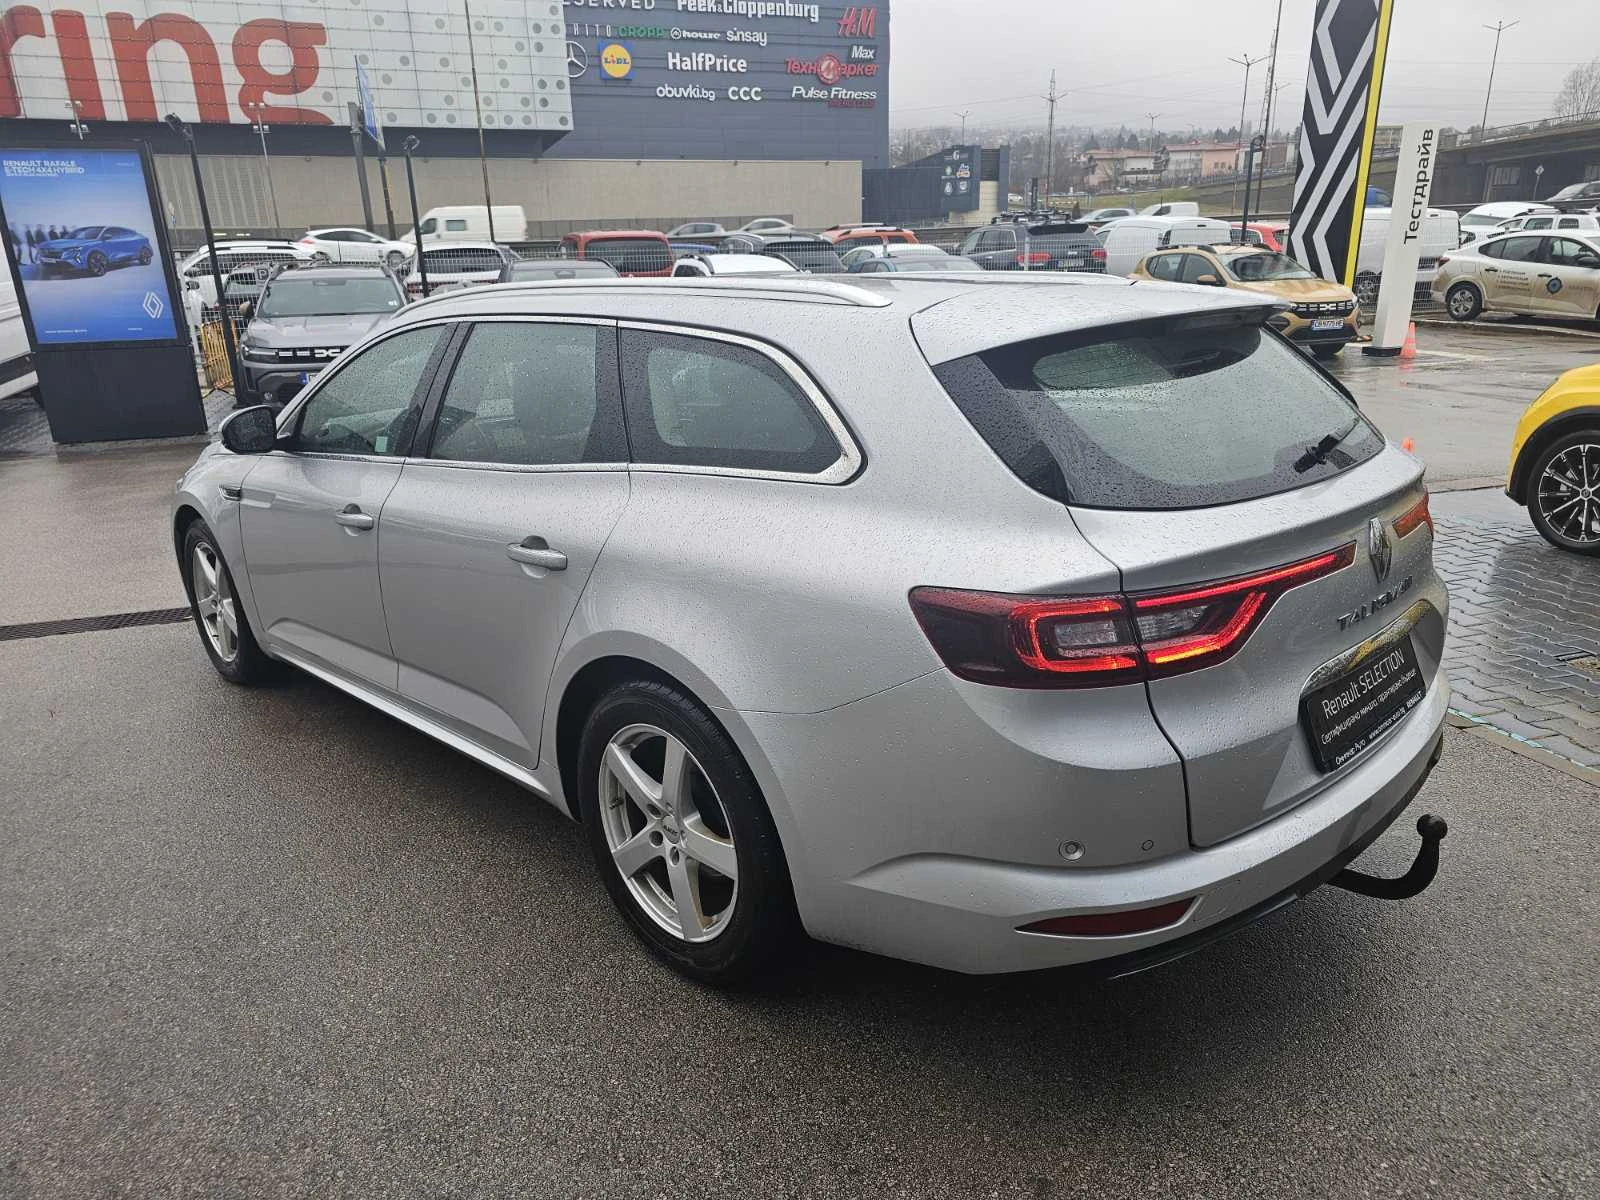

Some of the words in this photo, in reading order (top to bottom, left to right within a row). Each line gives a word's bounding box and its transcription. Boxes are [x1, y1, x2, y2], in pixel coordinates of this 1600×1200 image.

[837, 7, 878, 38] H&M
[667, 51, 748, 72] HalfPrice
[851, 45, 875, 59] Max
[656, 84, 717, 101] obuvki.bg
[727, 86, 763, 101] CCC
[791, 85, 828, 99] Pulse
[830, 87, 878, 100] Fitness
[1404, 128, 1434, 245] Тестдрайв
[1321, 681, 1361, 719] Renault
[1359, 647, 1405, 694] SELECTION
